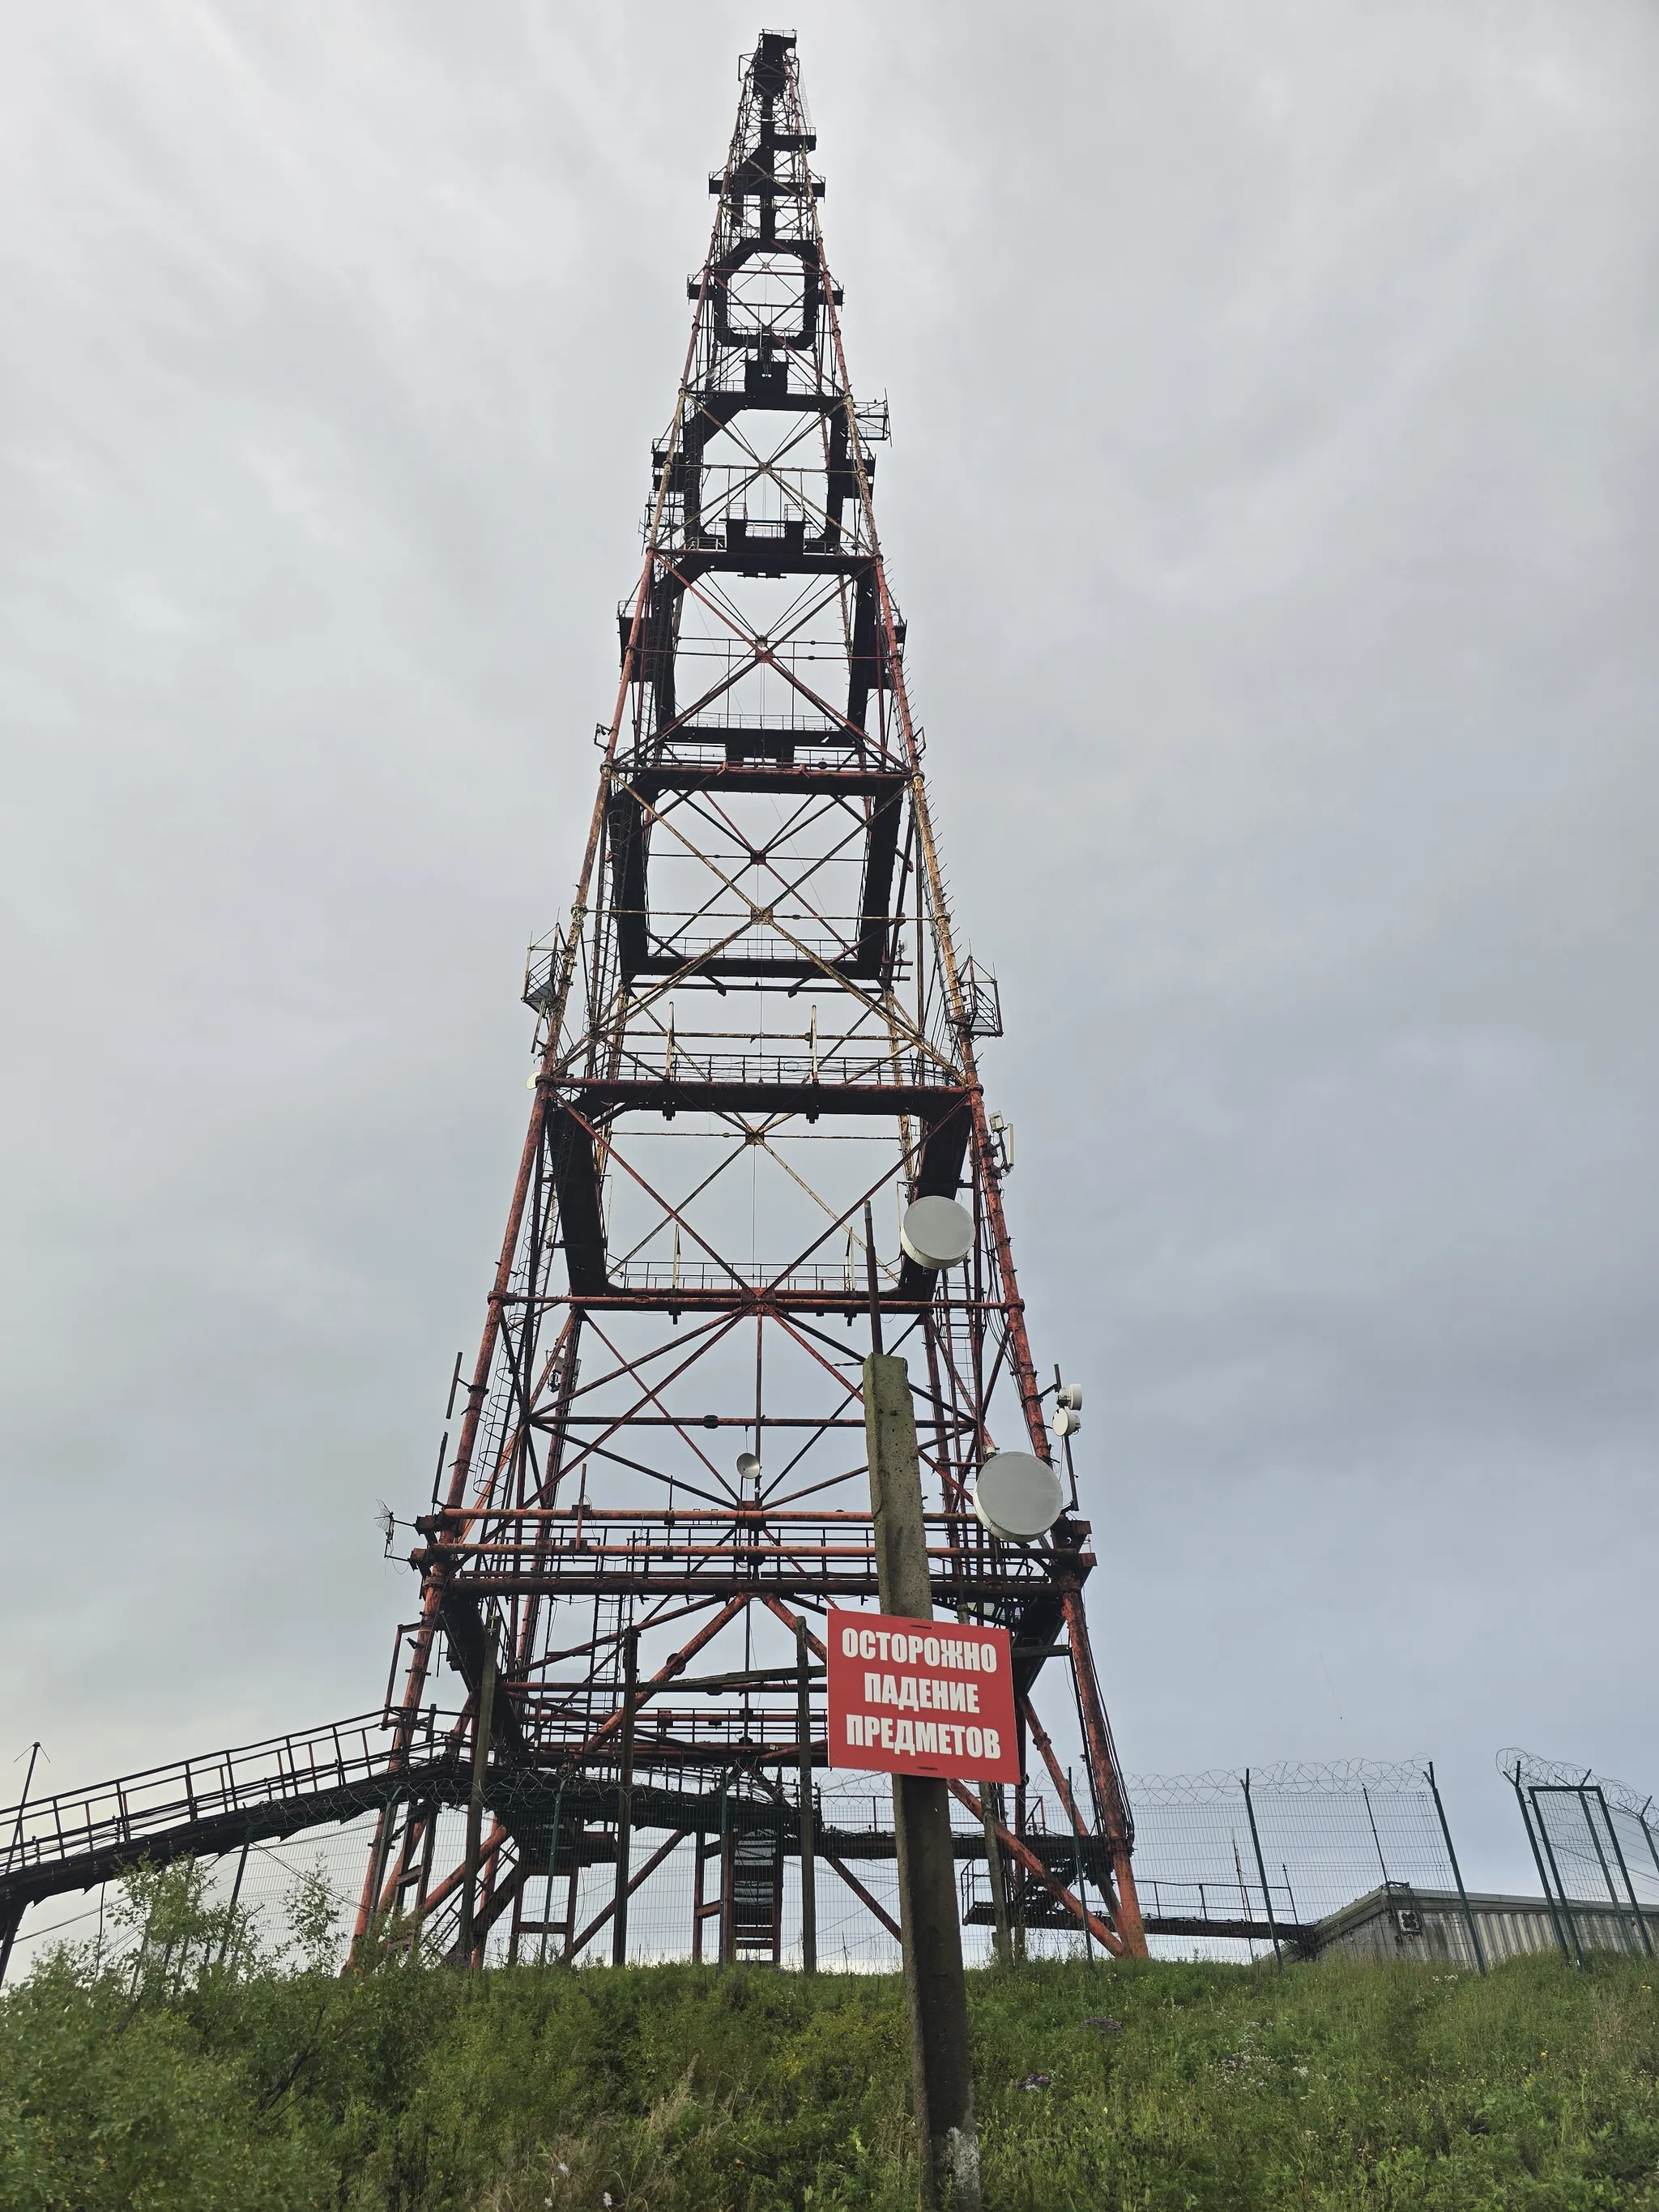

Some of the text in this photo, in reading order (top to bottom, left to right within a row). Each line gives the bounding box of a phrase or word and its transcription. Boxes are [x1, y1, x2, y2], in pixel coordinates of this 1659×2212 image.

[842, 1628, 997, 1673] ОСТОРОЖНО
[864, 1672, 980, 1714] ПАДЕНИЕ
[847, 1714, 1001, 1759] ПРЕДМЕТОВ
